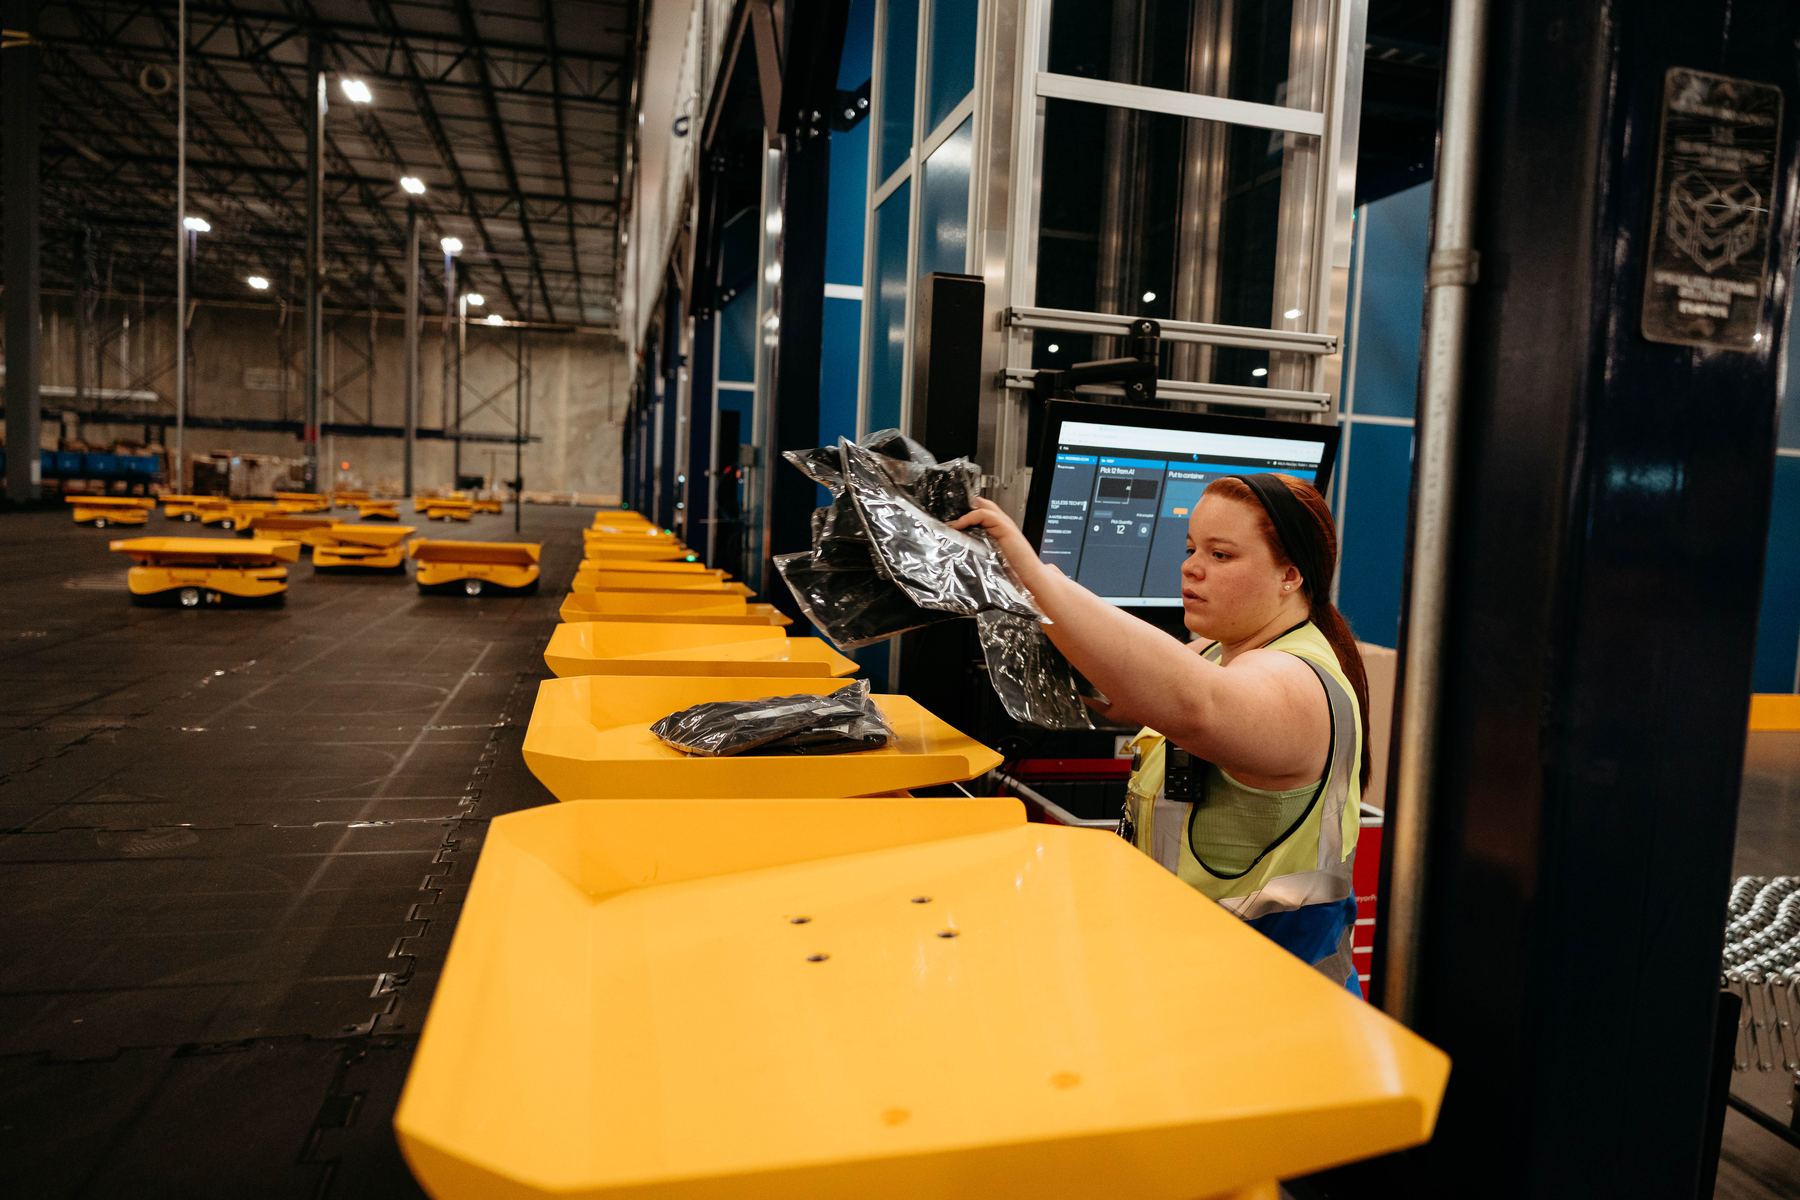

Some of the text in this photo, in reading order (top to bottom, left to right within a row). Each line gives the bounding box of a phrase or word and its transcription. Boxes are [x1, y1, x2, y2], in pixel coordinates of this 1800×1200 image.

[1100, 466, 1110, 474] Pick
[1183, 472, 1205, 480] container
[1116, 524, 1126, 535] 12
